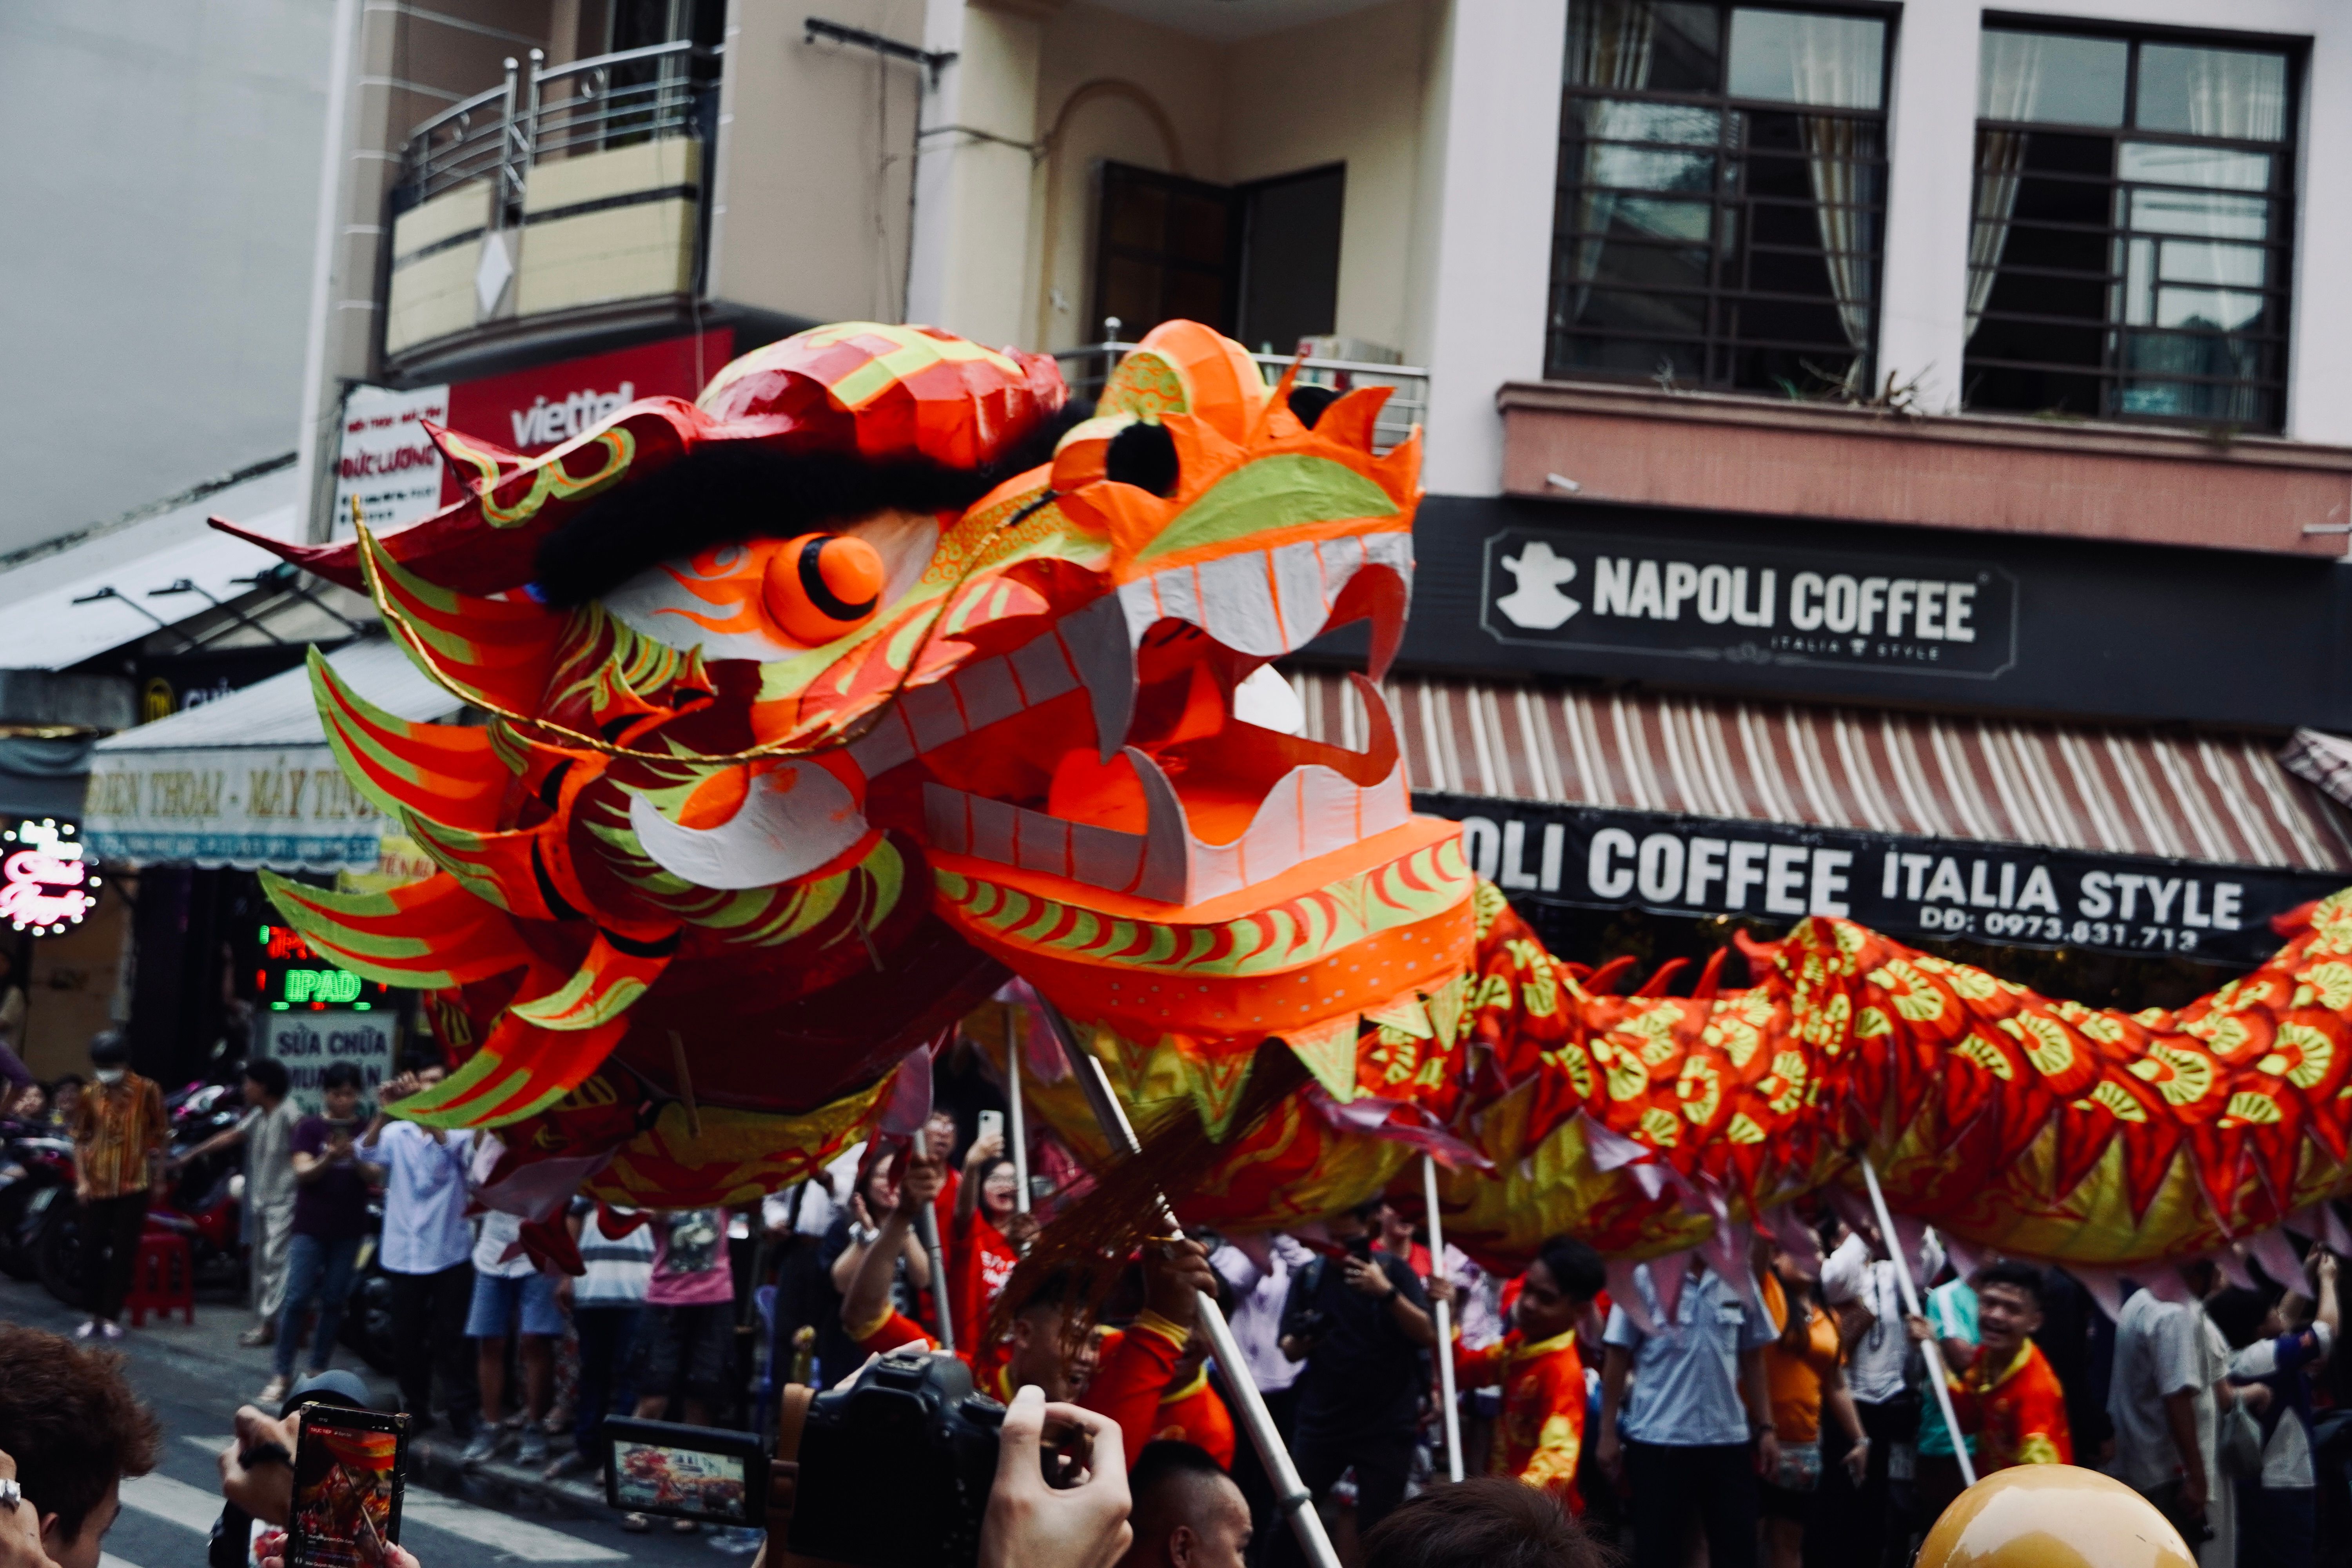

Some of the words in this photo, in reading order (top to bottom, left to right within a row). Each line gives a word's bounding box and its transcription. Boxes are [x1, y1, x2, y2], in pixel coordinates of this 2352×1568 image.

[1592, 557, 1777, 628] NAPOLI
[1789, 570, 1978, 642] COFFEE
[1771, 635, 1841, 653] ITALIA
[1877, 642, 1940, 661] STYLE
[1460, 815, 1565, 893] OLI
[1588, 828, 1853, 917] COFFEE
[1882, 851, 2061, 915] ITALIA
[2078, 870, 2243, 931] STYLE
[285, 970, 361, 1002] IPAD
